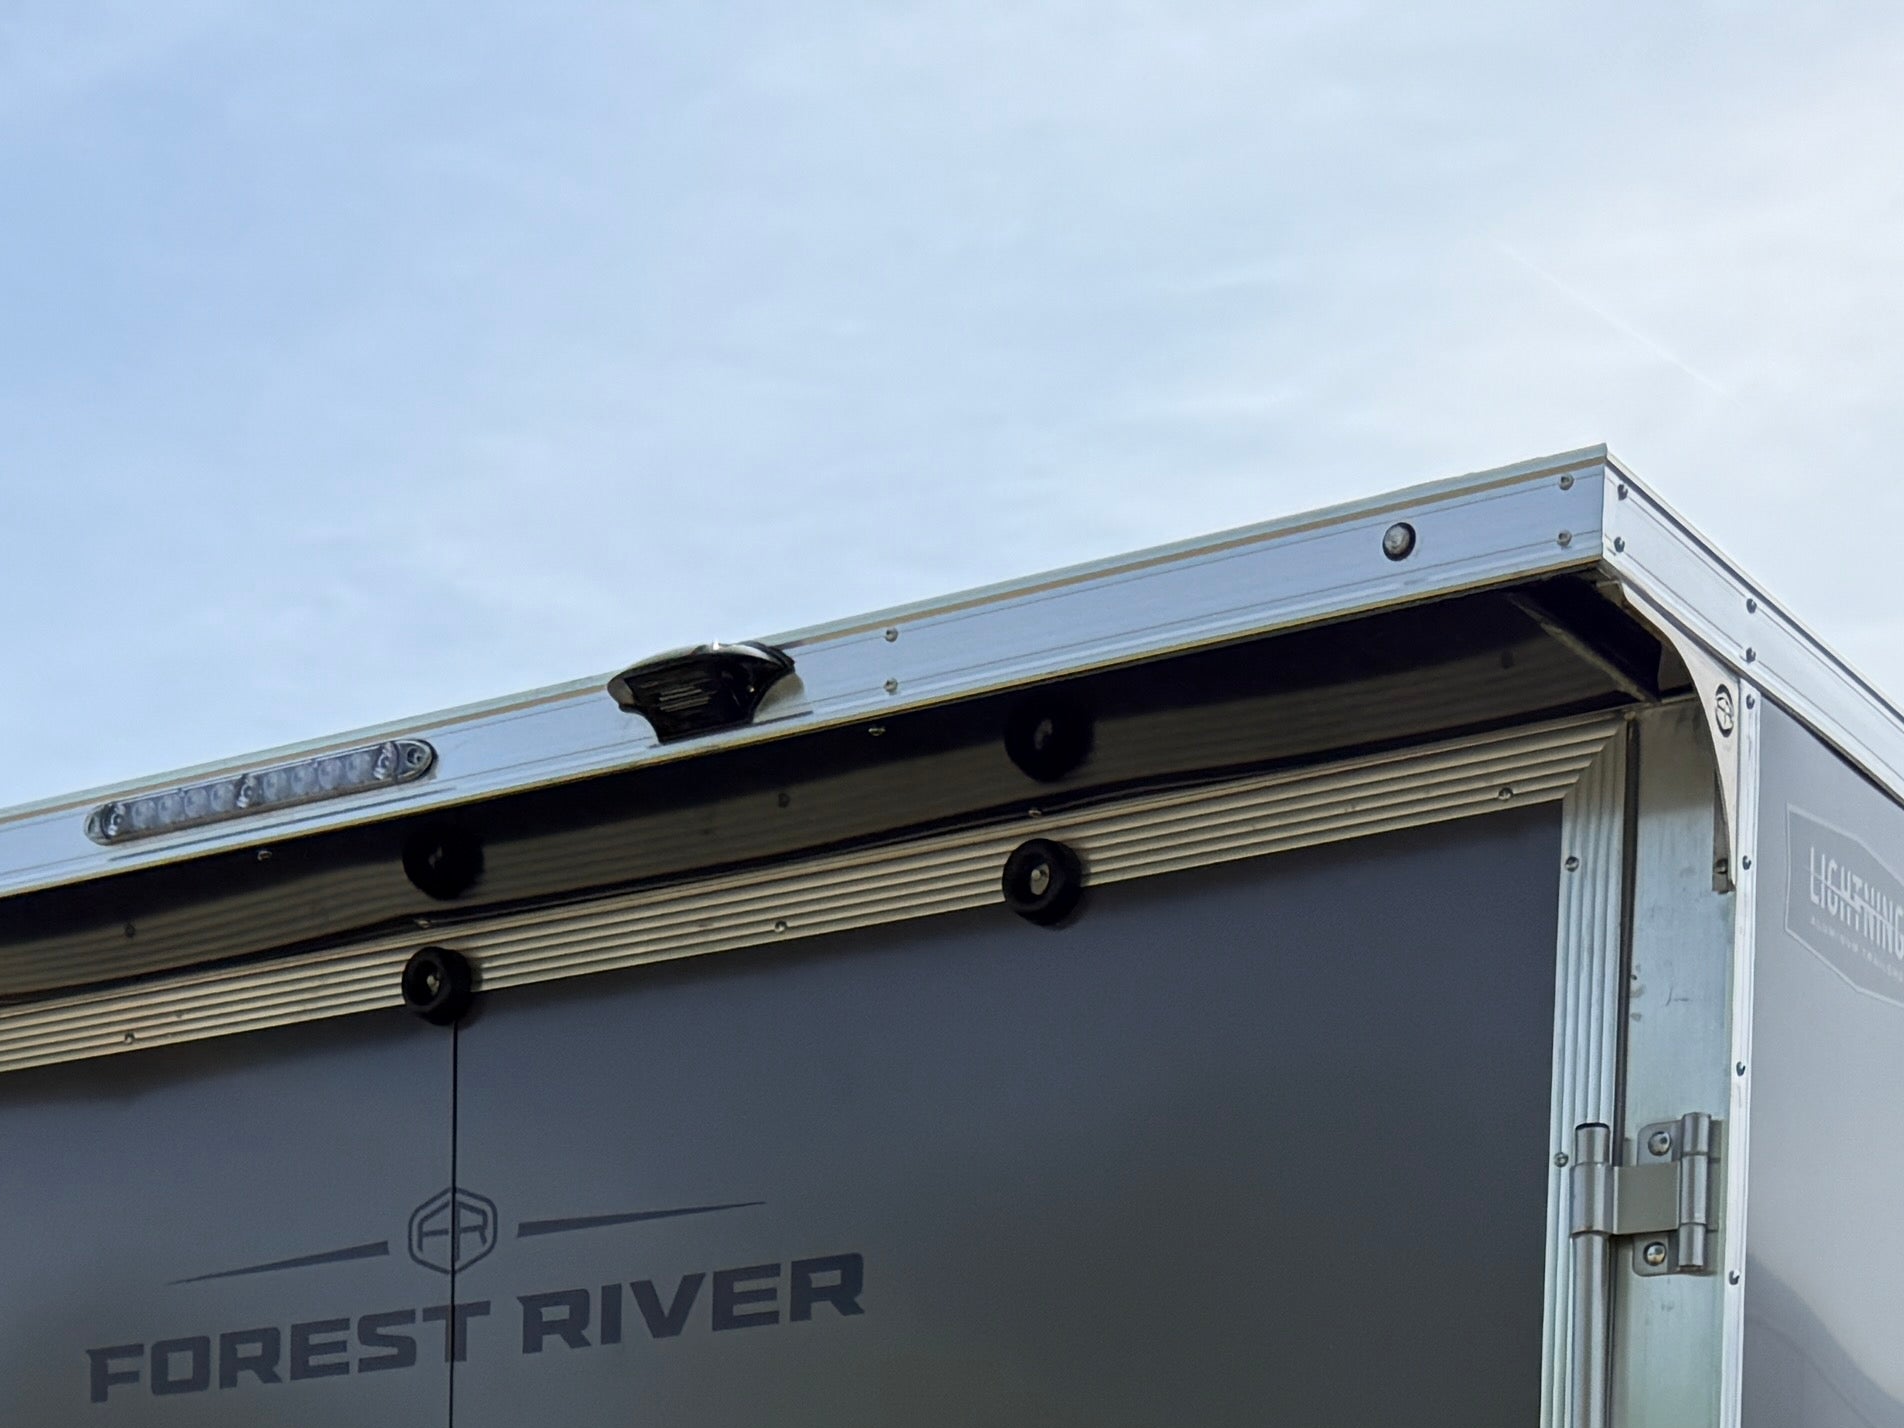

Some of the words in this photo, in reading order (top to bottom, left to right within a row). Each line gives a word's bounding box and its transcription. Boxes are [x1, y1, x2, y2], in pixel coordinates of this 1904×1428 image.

[1810, 845, 1904, 961] LIGHTNING
[85, 1300, 492, 1404] FOREST
[516, 1252, 866, 1355] RIVER
